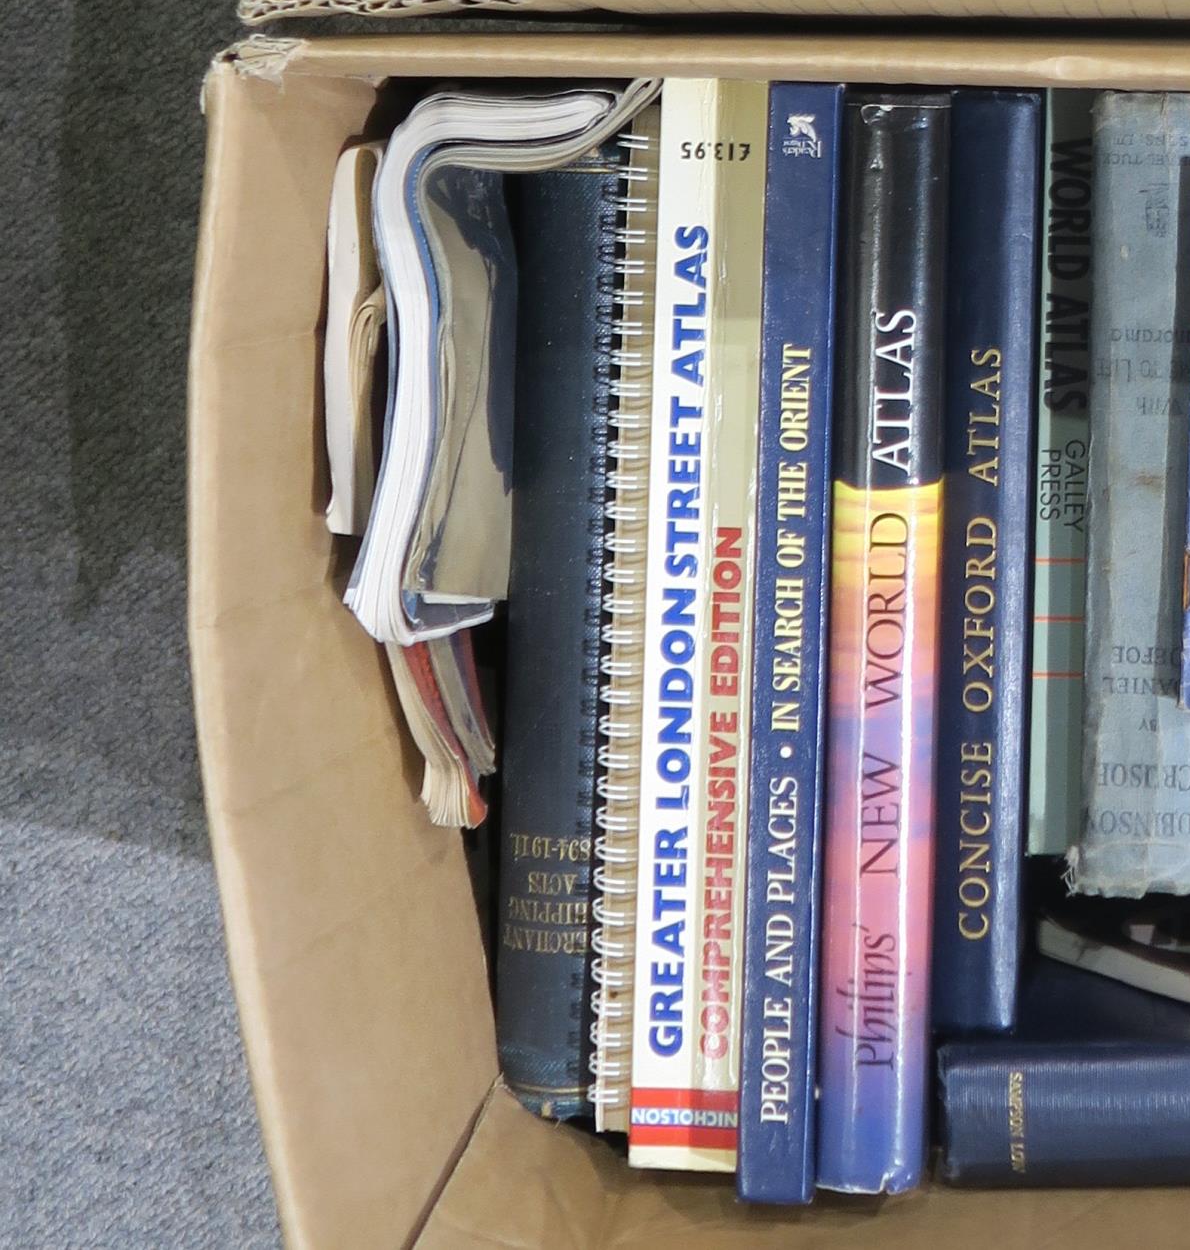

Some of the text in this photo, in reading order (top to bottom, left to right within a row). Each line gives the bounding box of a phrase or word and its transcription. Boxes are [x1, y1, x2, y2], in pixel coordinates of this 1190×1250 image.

[681, 141, 750, 162] £13.95
[1044, 138, 1093, 421] WORLD ATLAS
[873, 309, 917, 475] ATLAS
[1040, 449, 1061, 522] PRESS
[1064, 439, 1085, 533] GALLEY
[648, 225, 709, 1058] GREATER LONDON STREET ATLAS
[866, 513, 909, 709] WORLD
[959, 348, 1001, 940] CONCISE OXFORD ATLAS
[699, 526, 742, 1061] COMPREHENSIVE EDITION
[760, 343, 812, 1125] PEOPLE AND PLACES IN SEARCH OF THE ORIENT
[861, 752, 901, 878] NEW
[504, 924, 589, 954] ERCHANT
[506, 898, 589, 926] HIPPING
[528, 871, 576, 895] ACTS
[631, 1107, 739, 1128] NICHOLSON
